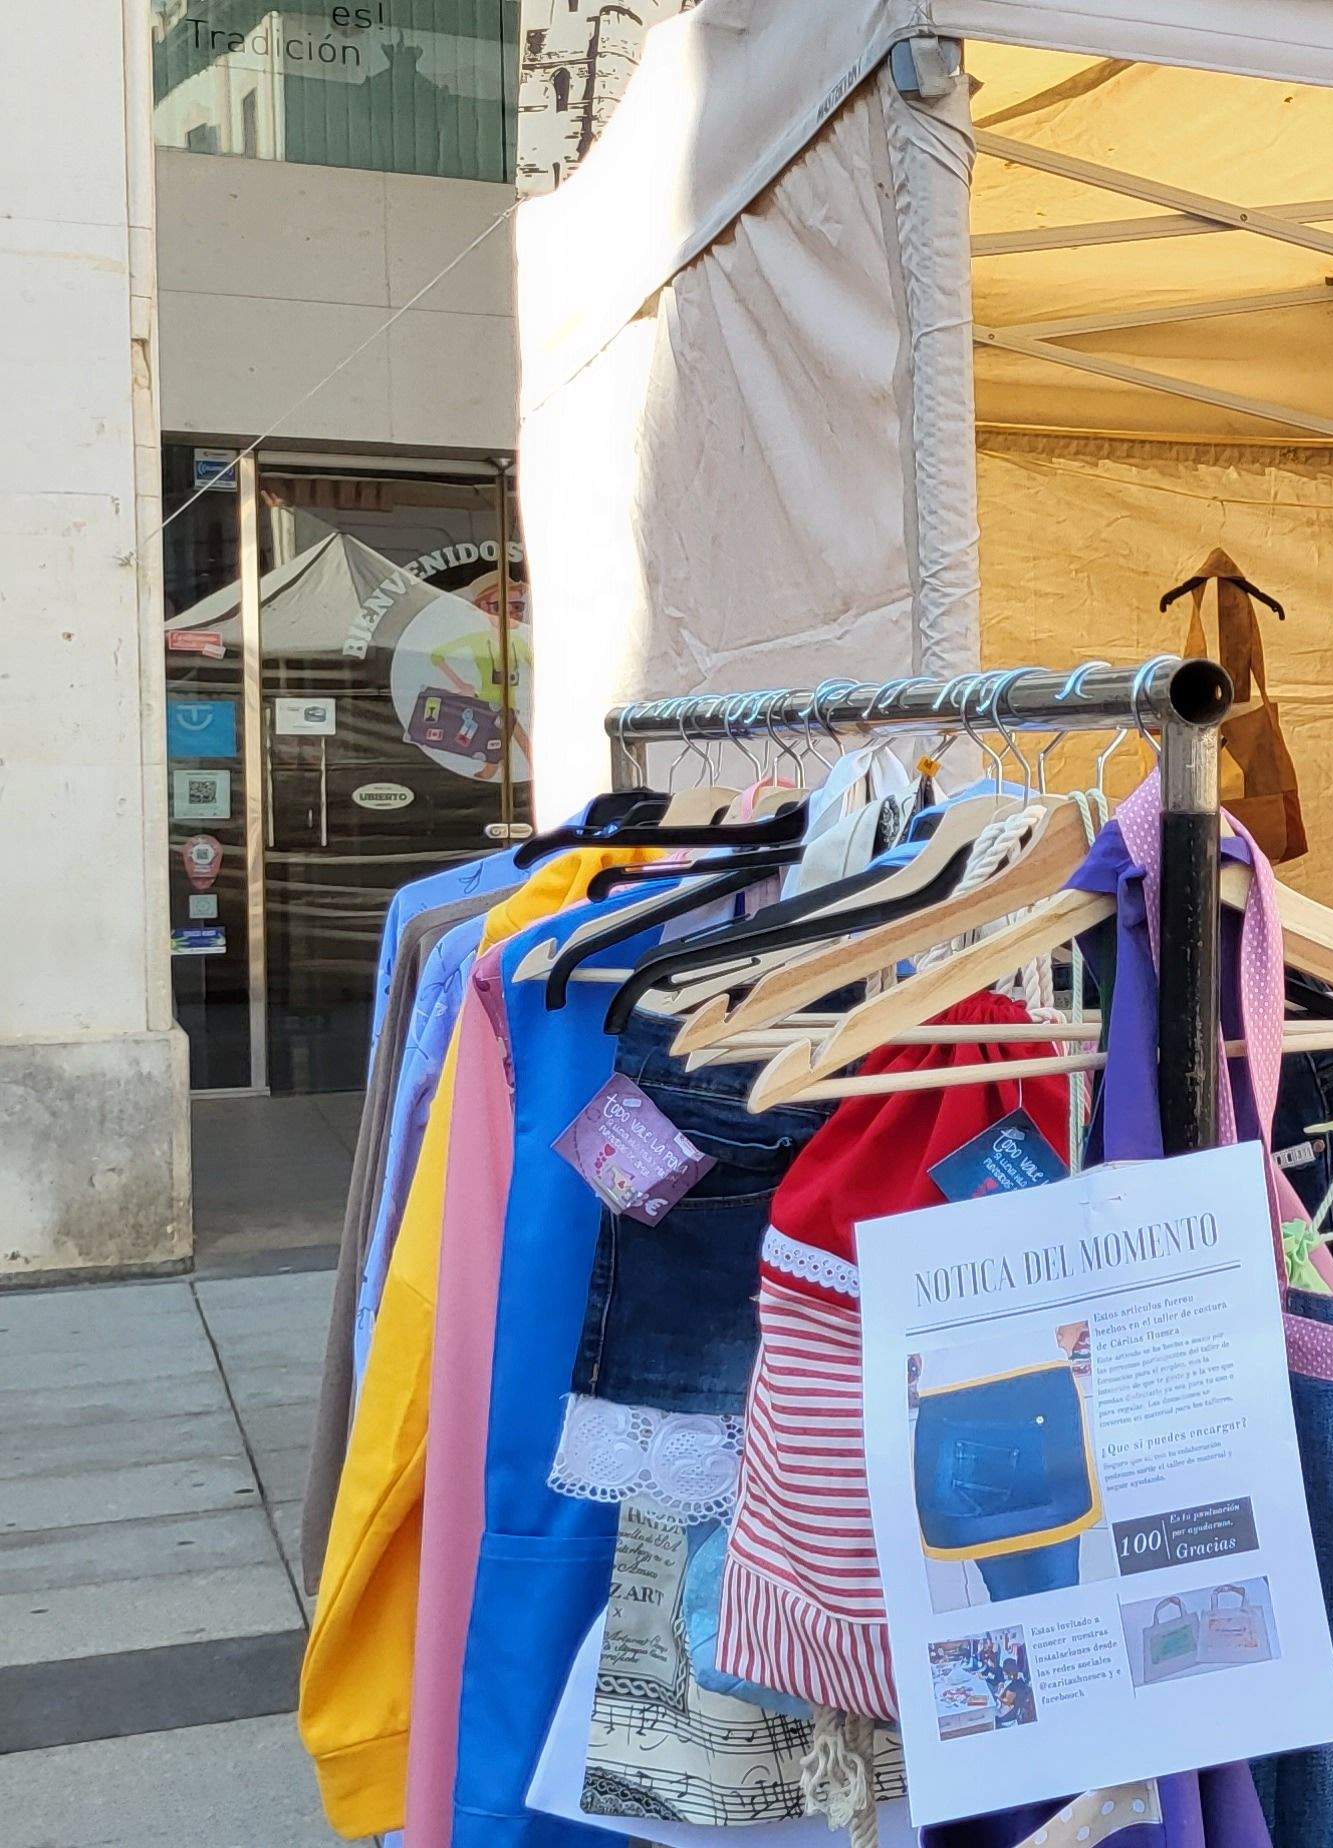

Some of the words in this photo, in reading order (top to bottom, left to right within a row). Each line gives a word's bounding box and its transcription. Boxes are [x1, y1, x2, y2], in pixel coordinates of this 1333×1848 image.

[332, 2, 385, 30] es!
[186, 18, 360, 66] Tradición
[343, 540, 523, 660] BIENVENIDOS
[914, 1255, 1017, 1308] NOTICA
[1023, 1243, 1074, 1286] DEL
[1079, 1212, 1219, 1274] MOMENTO
[1095, 1322, 1127, 1337] hechos
[1129, 1322, 1140, 1331] en
[1142, 1317, 1151, 1326] el
[1153, 1311, 1179, 1325] taller
[1181, 1308, 1192, 1318] de
[1194, 1301, 1228, 1315] costura
[1096, 1342, 1107, 1352] de
[1147, 1432, 1187, 1450] puedes
[1189, 1416, 1248, 1439] encargar?
[1120, 1530, 1162, 1557] 100
[1176, 1536, 1237, 1559] Gracias
